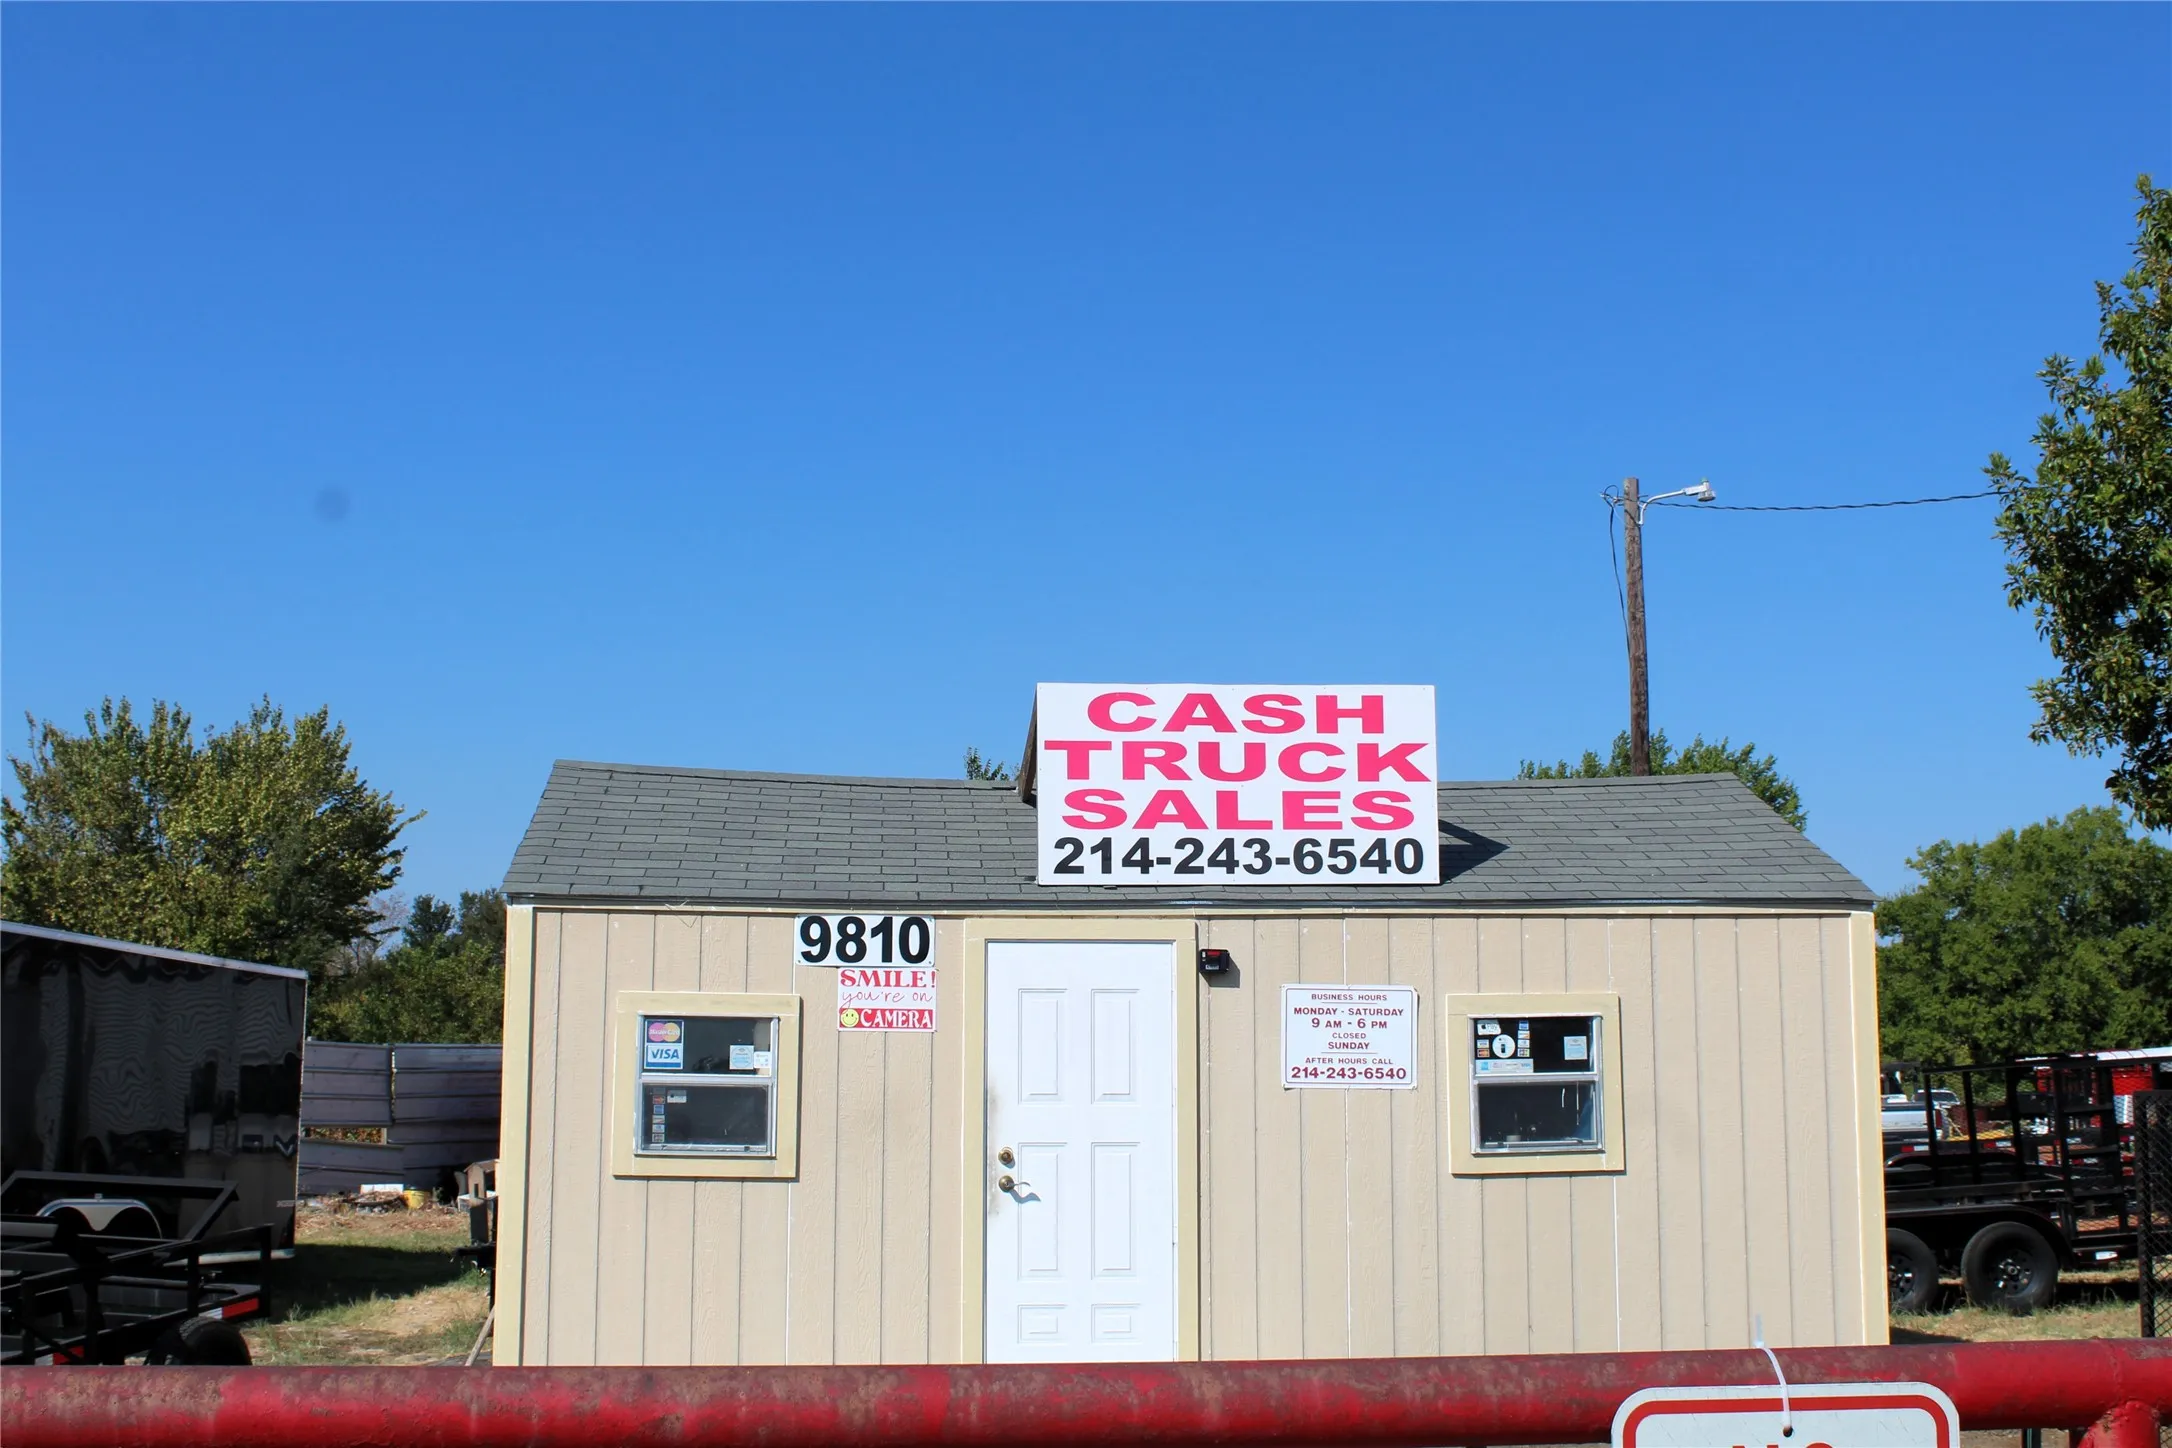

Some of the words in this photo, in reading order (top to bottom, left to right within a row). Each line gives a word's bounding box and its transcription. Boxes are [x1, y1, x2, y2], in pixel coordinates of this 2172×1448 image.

[1087, 692, 1385, 734] CASH
[1044, 740, 1431, 783] TRUCK
[1062, 788, 1415, 831] SALES
[1053, 836, 1424, 875] 214-243-6540
[800, 915, 930, 964] 9810
[840, 969, 936, 988] SMILE!
[840, 991, 905, 1010] you're
[912, 992, 933, 1003] on
[1311, 993, 1354, 1001] BUSINESS
[860, 1008, 932, 1028] CAMERA
[1293, 1007, 1338, 1015] MONDAY
[1348, 1008, 1404, 1016] SATURDAY
[1311, 1017, 1320, 1028] 9
[1325, 1020, 1342, 1028] AM
[1357, 1018, 1366, 1029] 6
[1371, 1020, 1388, 1029] PM
[651, 1048, 680, 1060] VISA
[1328, 1041, 1370, 1050] SUNDAY
[1371, 1057, 1394, 1065] CALL
[1291, 1066, 1407, 1080] 214-243-6540
